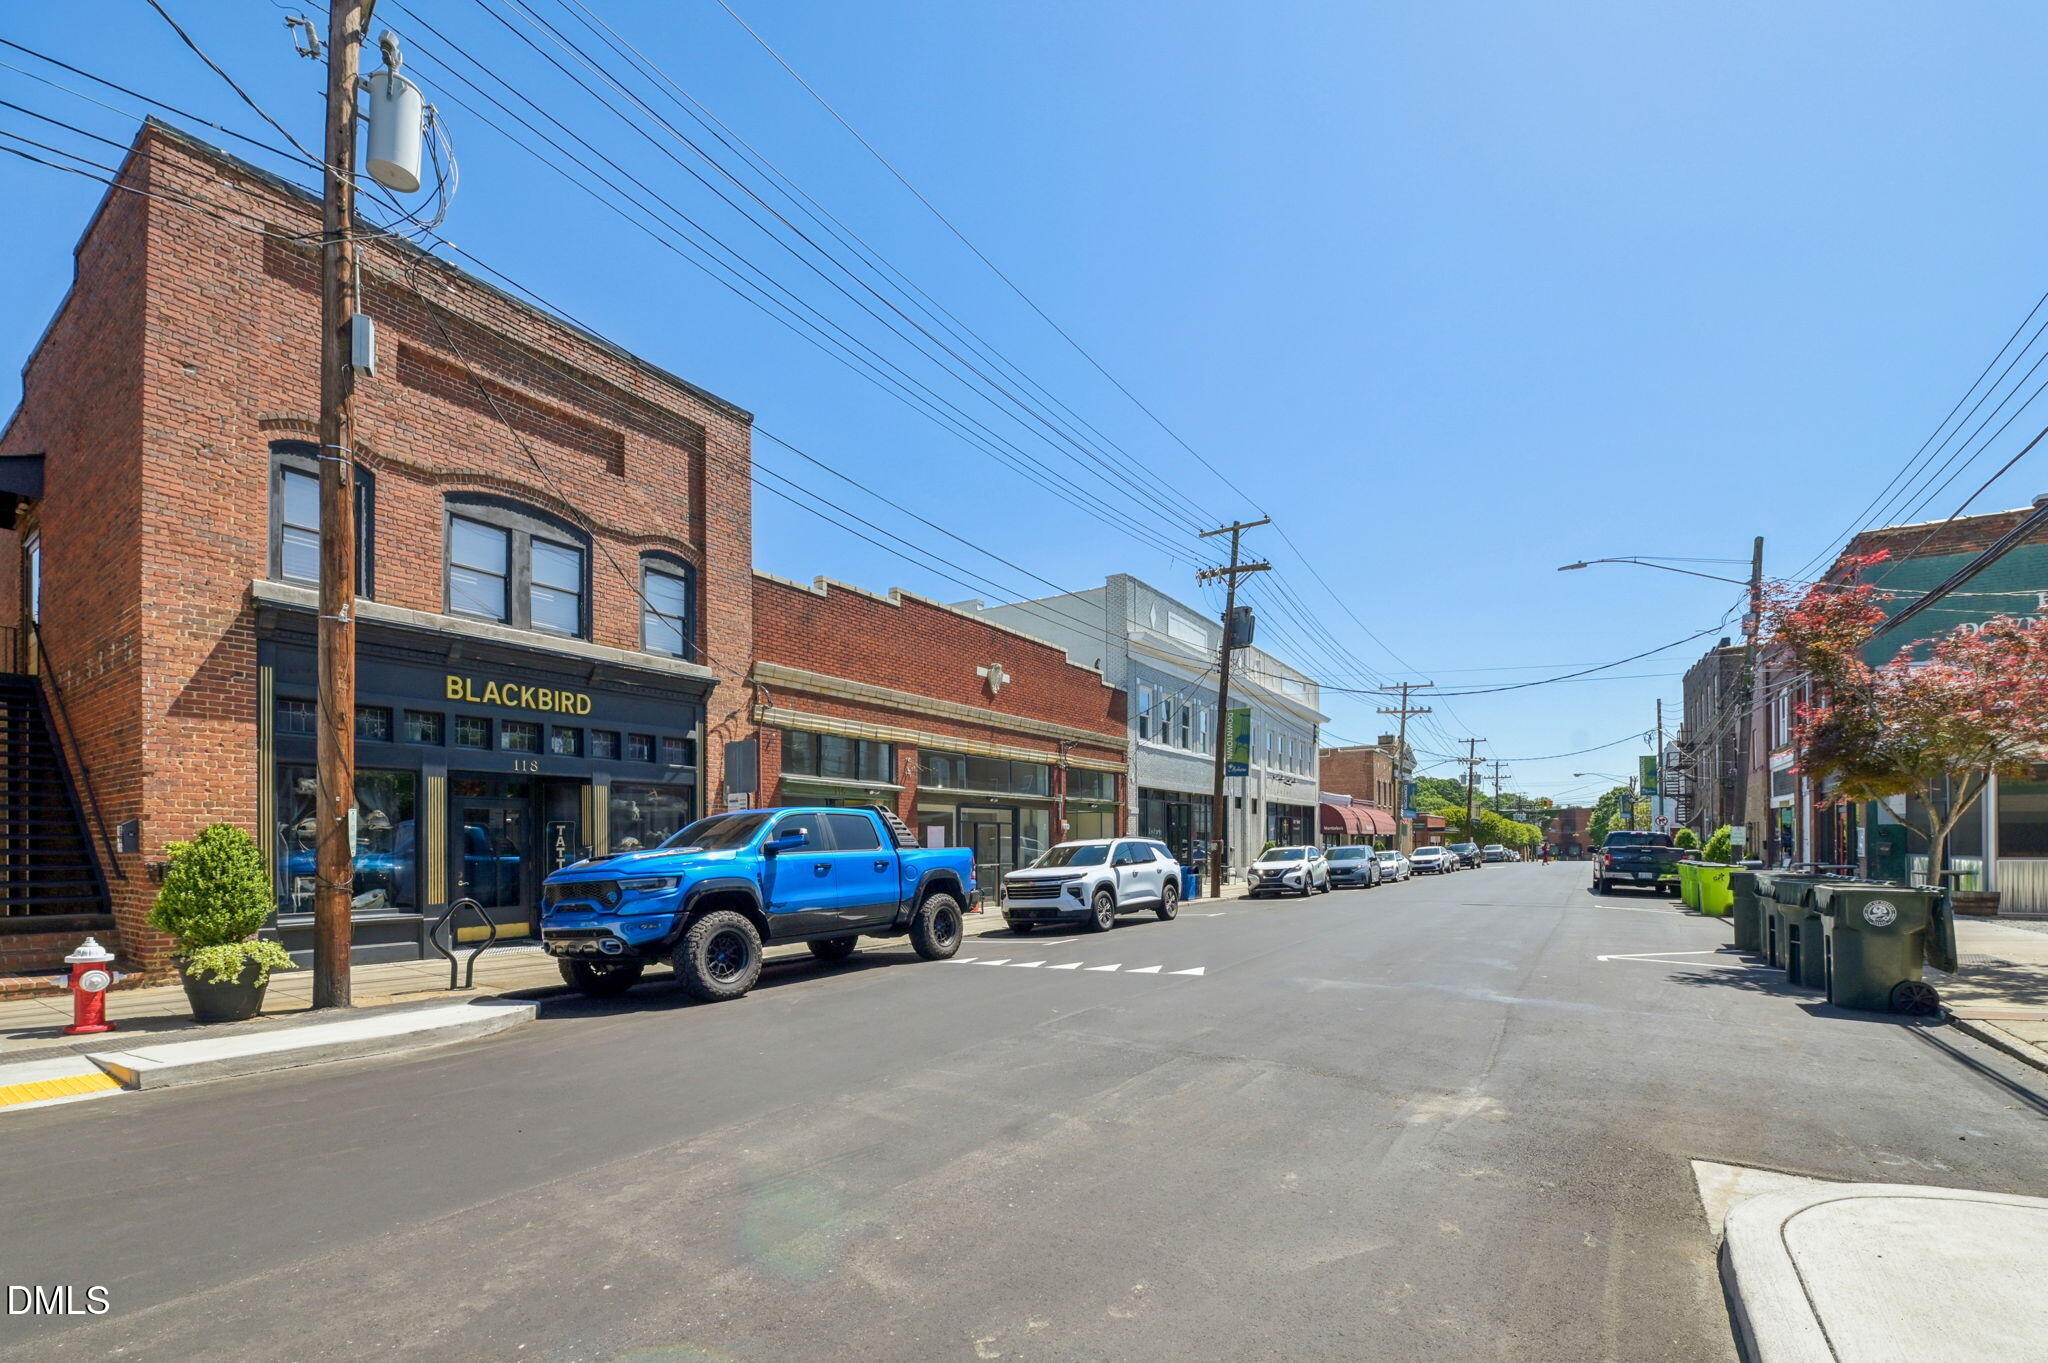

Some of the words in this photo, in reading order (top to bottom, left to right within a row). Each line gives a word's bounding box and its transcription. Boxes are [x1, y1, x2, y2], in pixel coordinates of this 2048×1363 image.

[446, 675, 592, 715] BLACKBIRD
[1226, 712, 1234, 761] DOWNTOWN
[513, 758, 539, 772] 118
[555, 825, 566, 869] TATT
